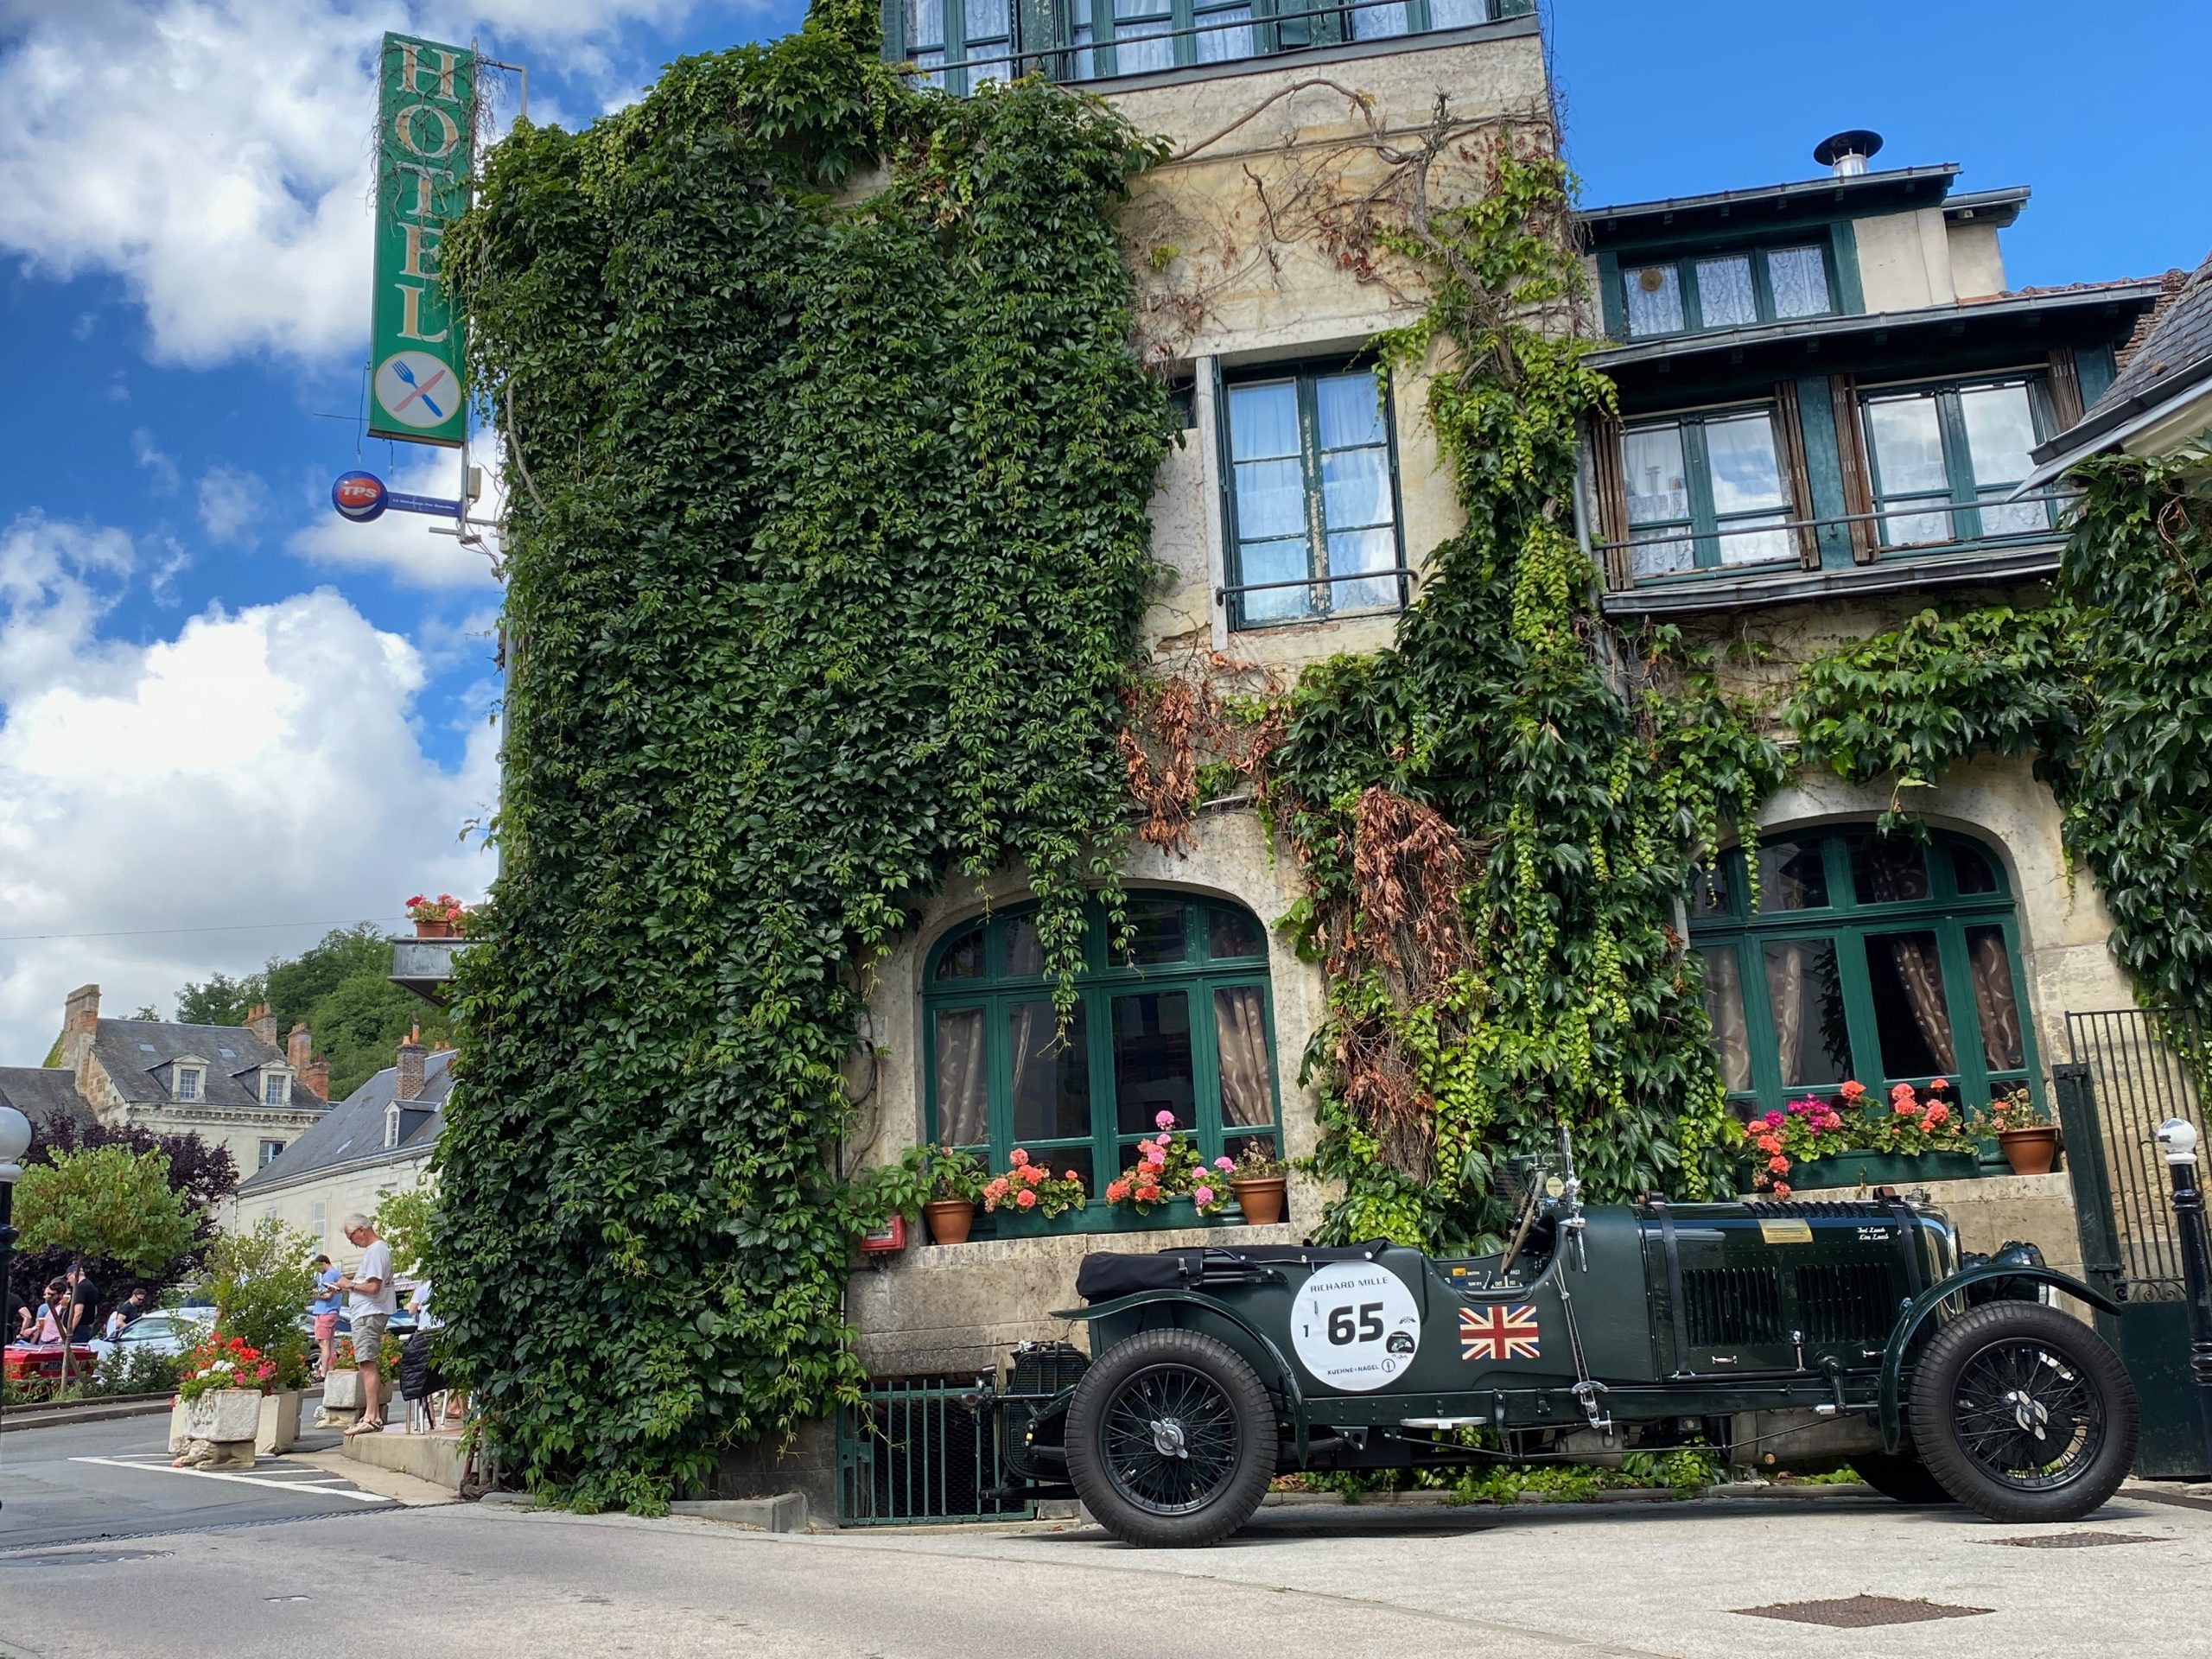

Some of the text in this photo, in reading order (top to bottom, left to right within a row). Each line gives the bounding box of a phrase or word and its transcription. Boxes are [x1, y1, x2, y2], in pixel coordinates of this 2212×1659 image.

[394, 40, 463, 342] HOTEL
[342, 486, 378, 499] TPS
[1310, 1276, 1389, 1293] RICHARD MILLE
[1328, 1301, 1383, 1345] 65
[1303, 1324, 1308, 1338] 1
[1327, 1364, 1379, 1376] KUEHNE+NAGEL
